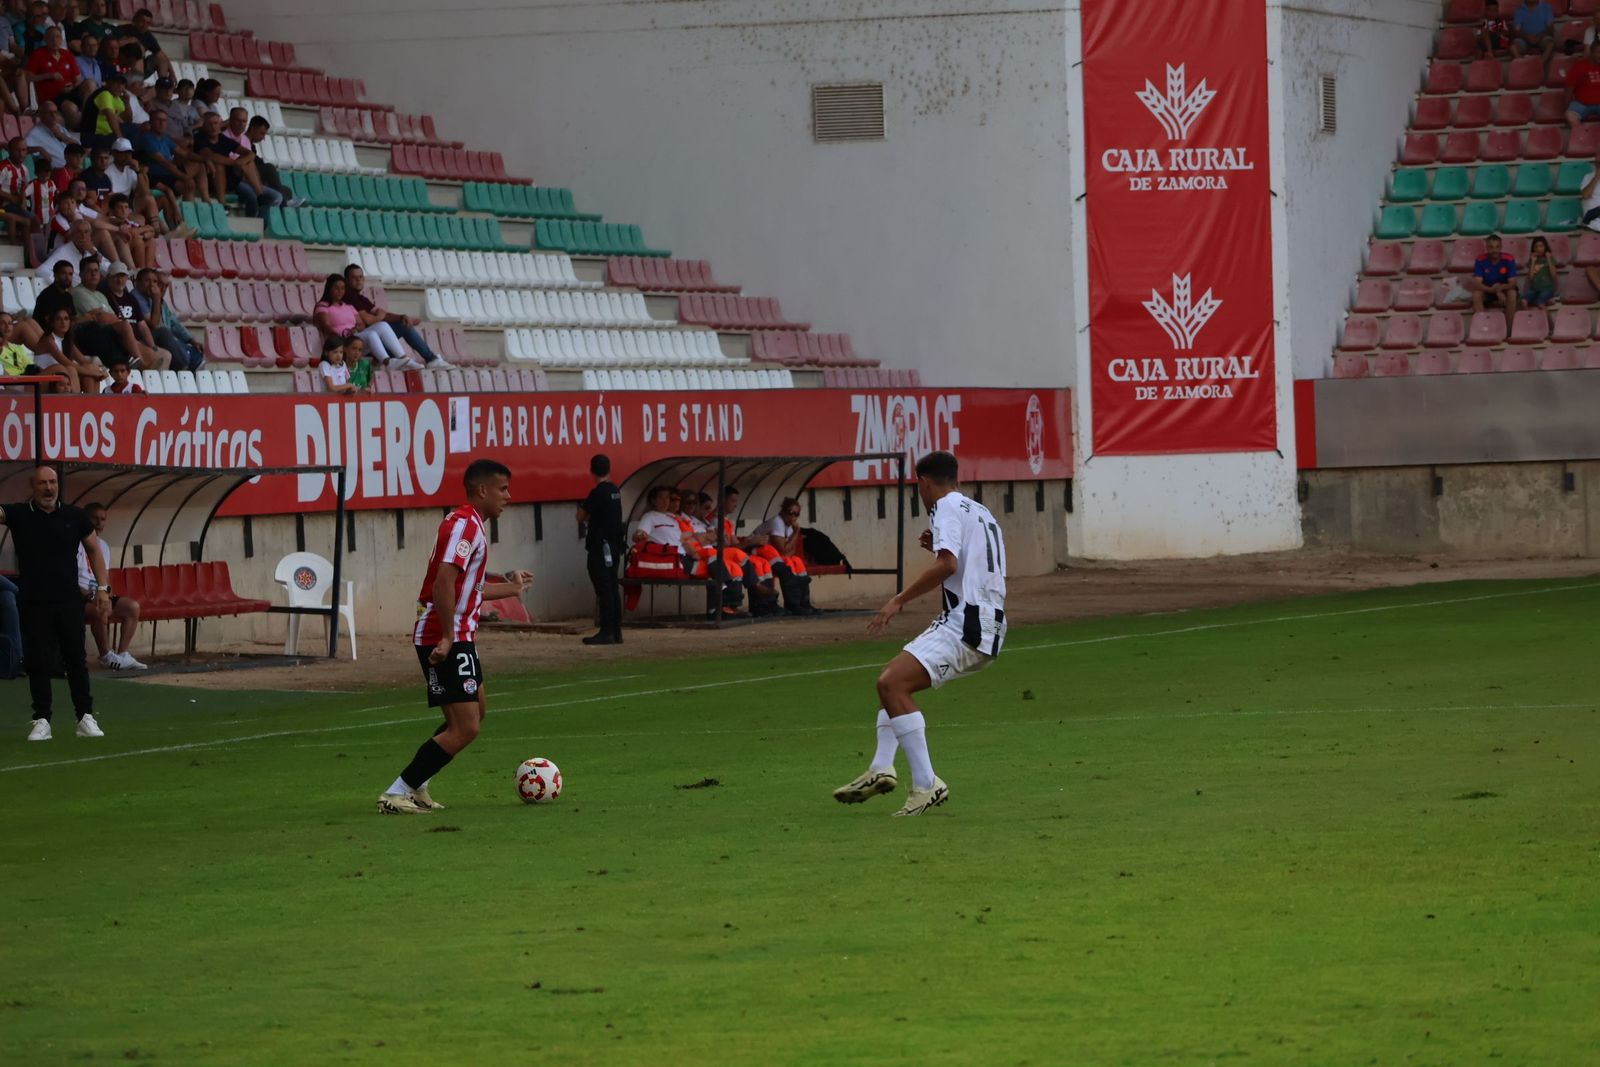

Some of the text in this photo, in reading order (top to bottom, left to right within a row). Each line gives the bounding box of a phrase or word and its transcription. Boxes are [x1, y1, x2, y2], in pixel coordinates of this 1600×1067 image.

[1101, 147, 1254, 173] CAJA RURAL
[1129, 176, 1228, 191] DE ZAMORA
[1107, 356, 1259, 382] CAJA RURAL
[1135, 384, 1233, 400] DE ZAMORA
[472, 393, 744, 448] FABRICACIÓN DE STAND
[0, 399, 263, 484] ÓTULOS Gráficas
[294, 398, 446, 503] DUERO
[978, 515, 1003, 576] 11
[456, 652, 476, 677] 21
